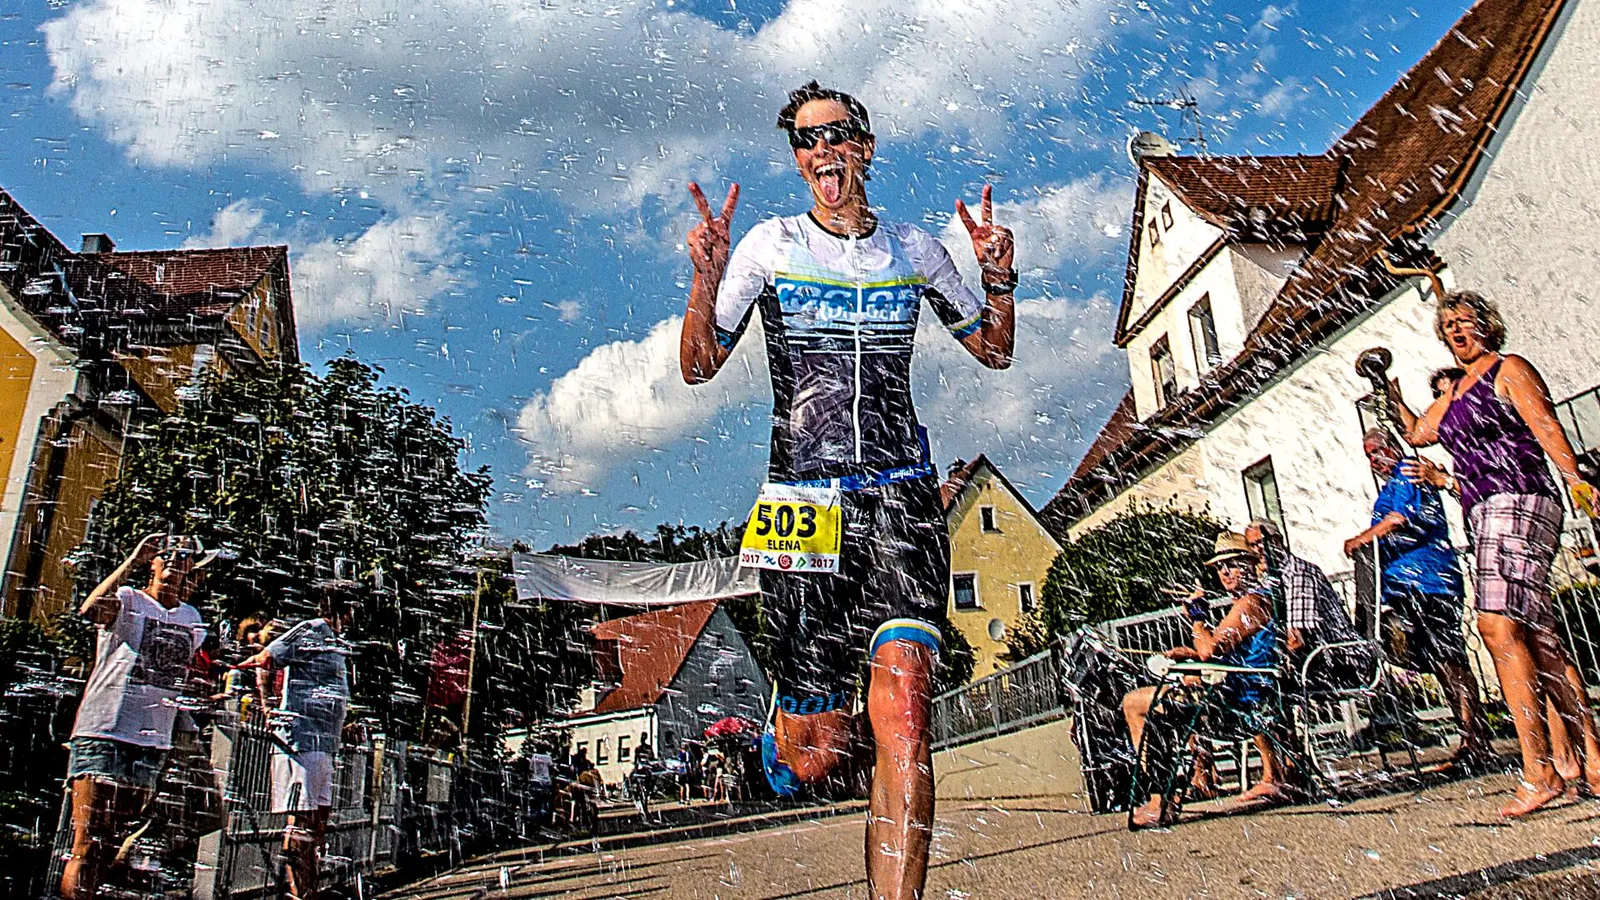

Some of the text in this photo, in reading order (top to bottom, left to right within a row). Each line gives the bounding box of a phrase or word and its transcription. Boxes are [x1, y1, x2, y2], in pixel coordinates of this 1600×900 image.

[755, 503, 817, 538] 503
[767, 539, 801, 551] ELENA
[741, 553, 835, 569] 2017 2017
